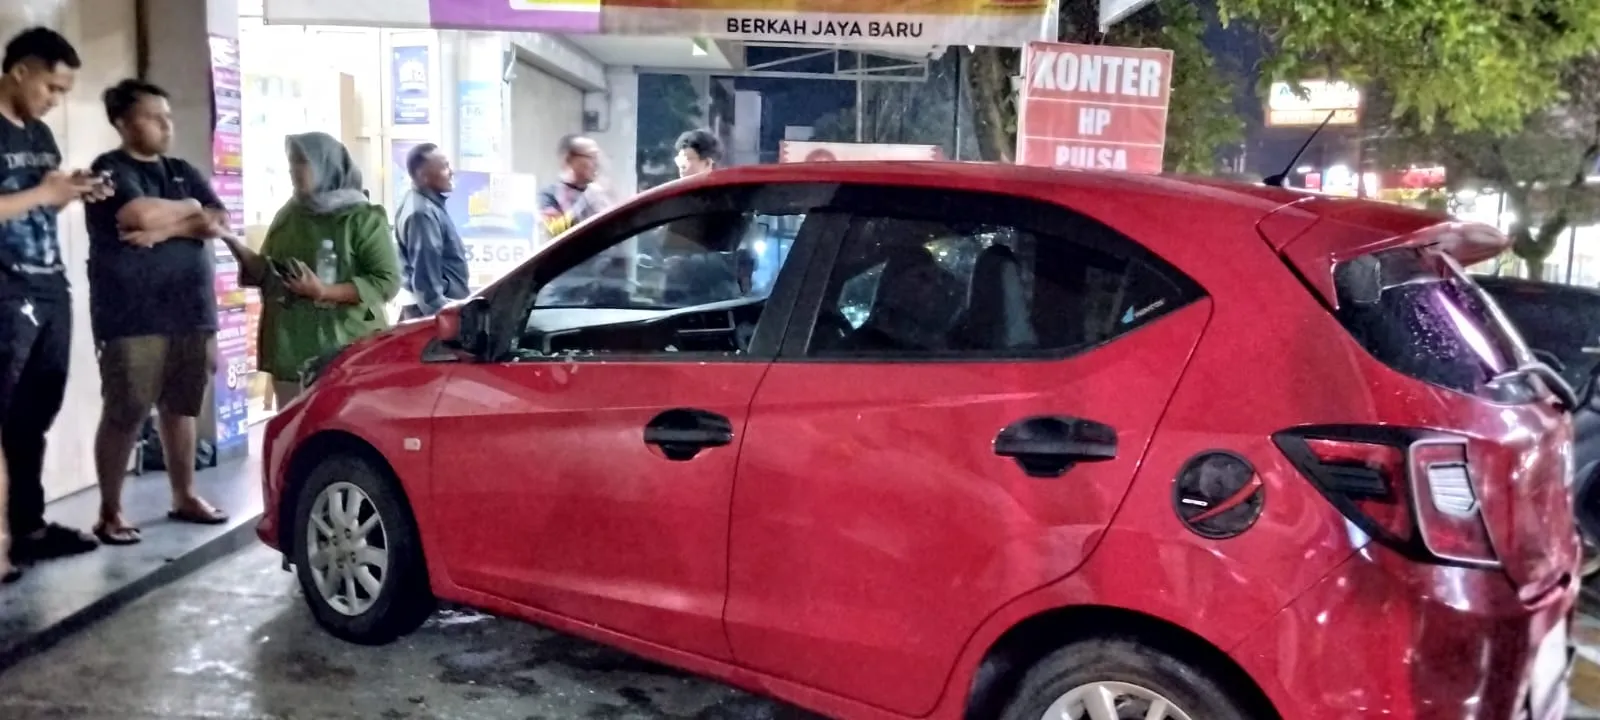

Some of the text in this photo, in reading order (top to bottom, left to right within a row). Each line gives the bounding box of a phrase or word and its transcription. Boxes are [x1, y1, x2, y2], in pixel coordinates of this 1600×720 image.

[726, 17, 923, 37] BERKAH JAYA BARU
[1033, 51, 1162, 97] KONTER
[1078, 107, 1111, 135] HP
